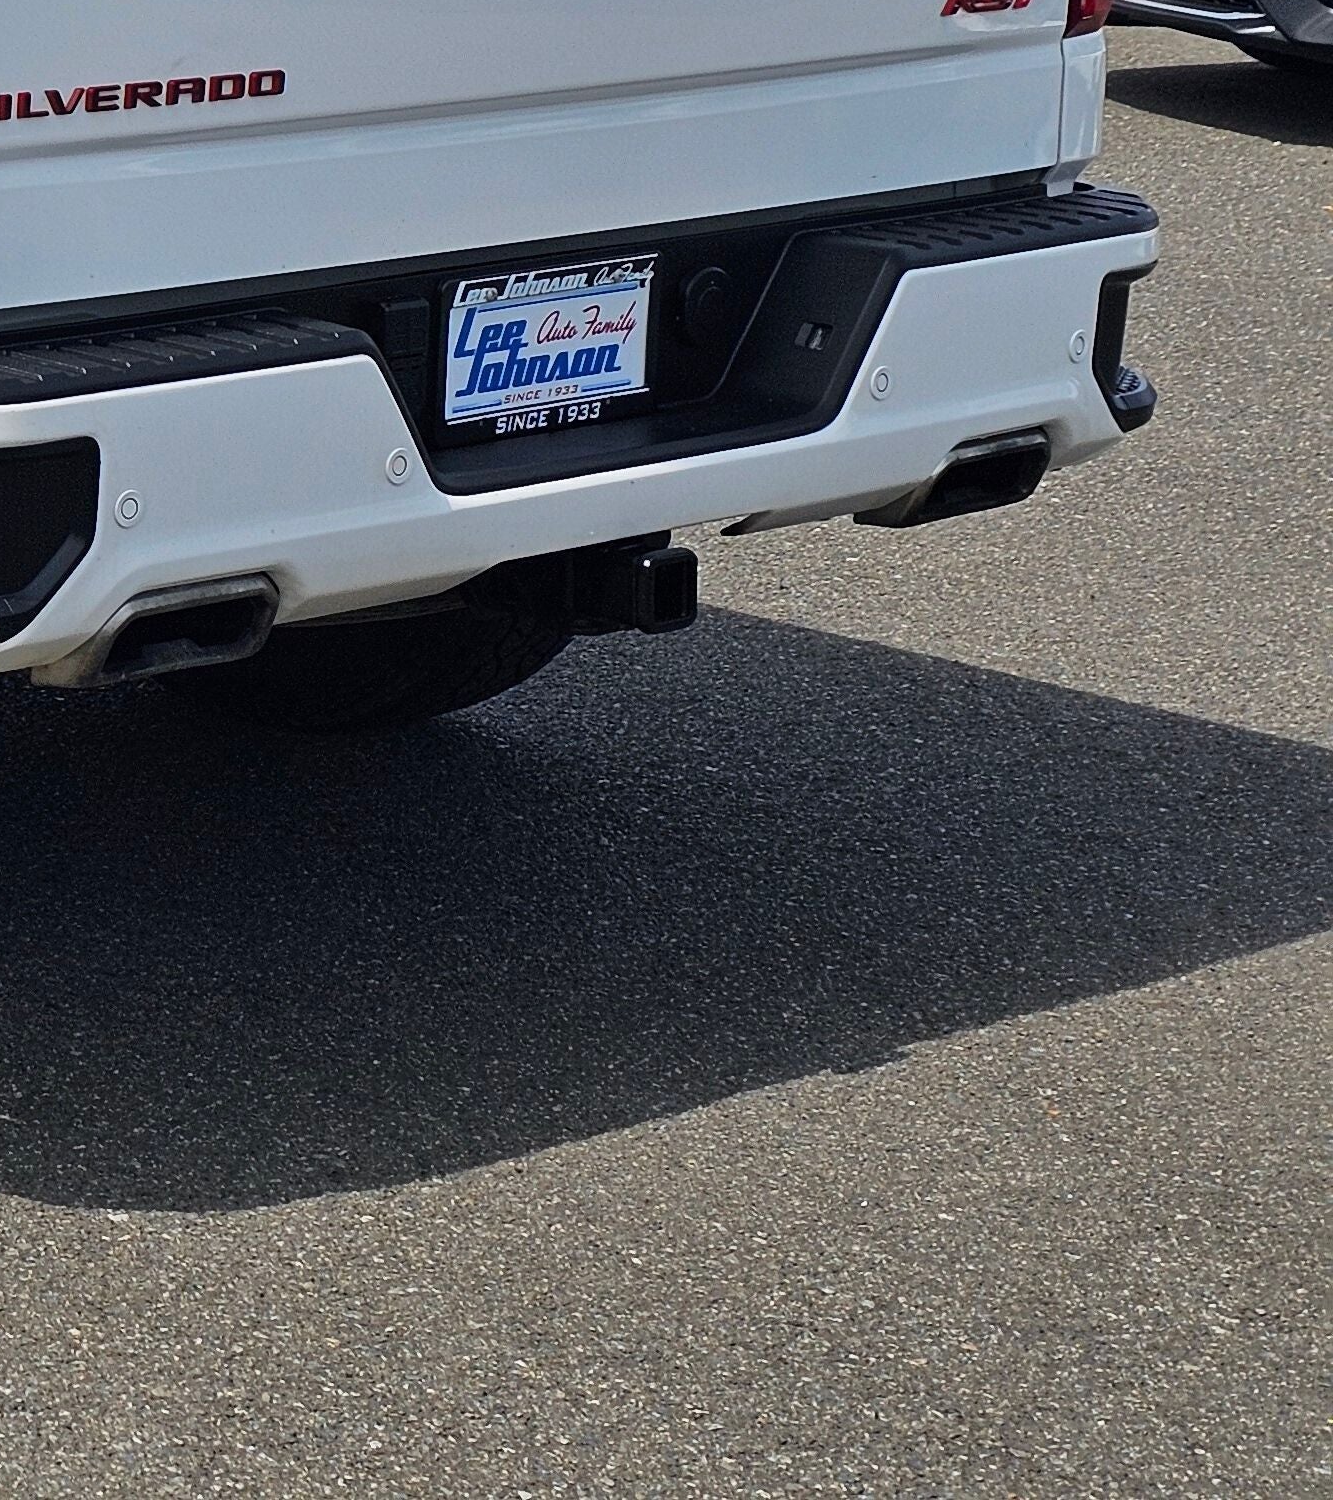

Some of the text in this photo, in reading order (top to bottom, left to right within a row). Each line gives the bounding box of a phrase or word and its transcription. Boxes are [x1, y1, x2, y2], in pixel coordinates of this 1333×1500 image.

[497, 270, 588, 301] Johnson
[454, 300, 637, 358] Lee Auto Family
[455, 342, 621, 398] Johnson
[504, 384, 579, 405] SINCE 1933
[495, 402, 601, 434] SINCE 1933
